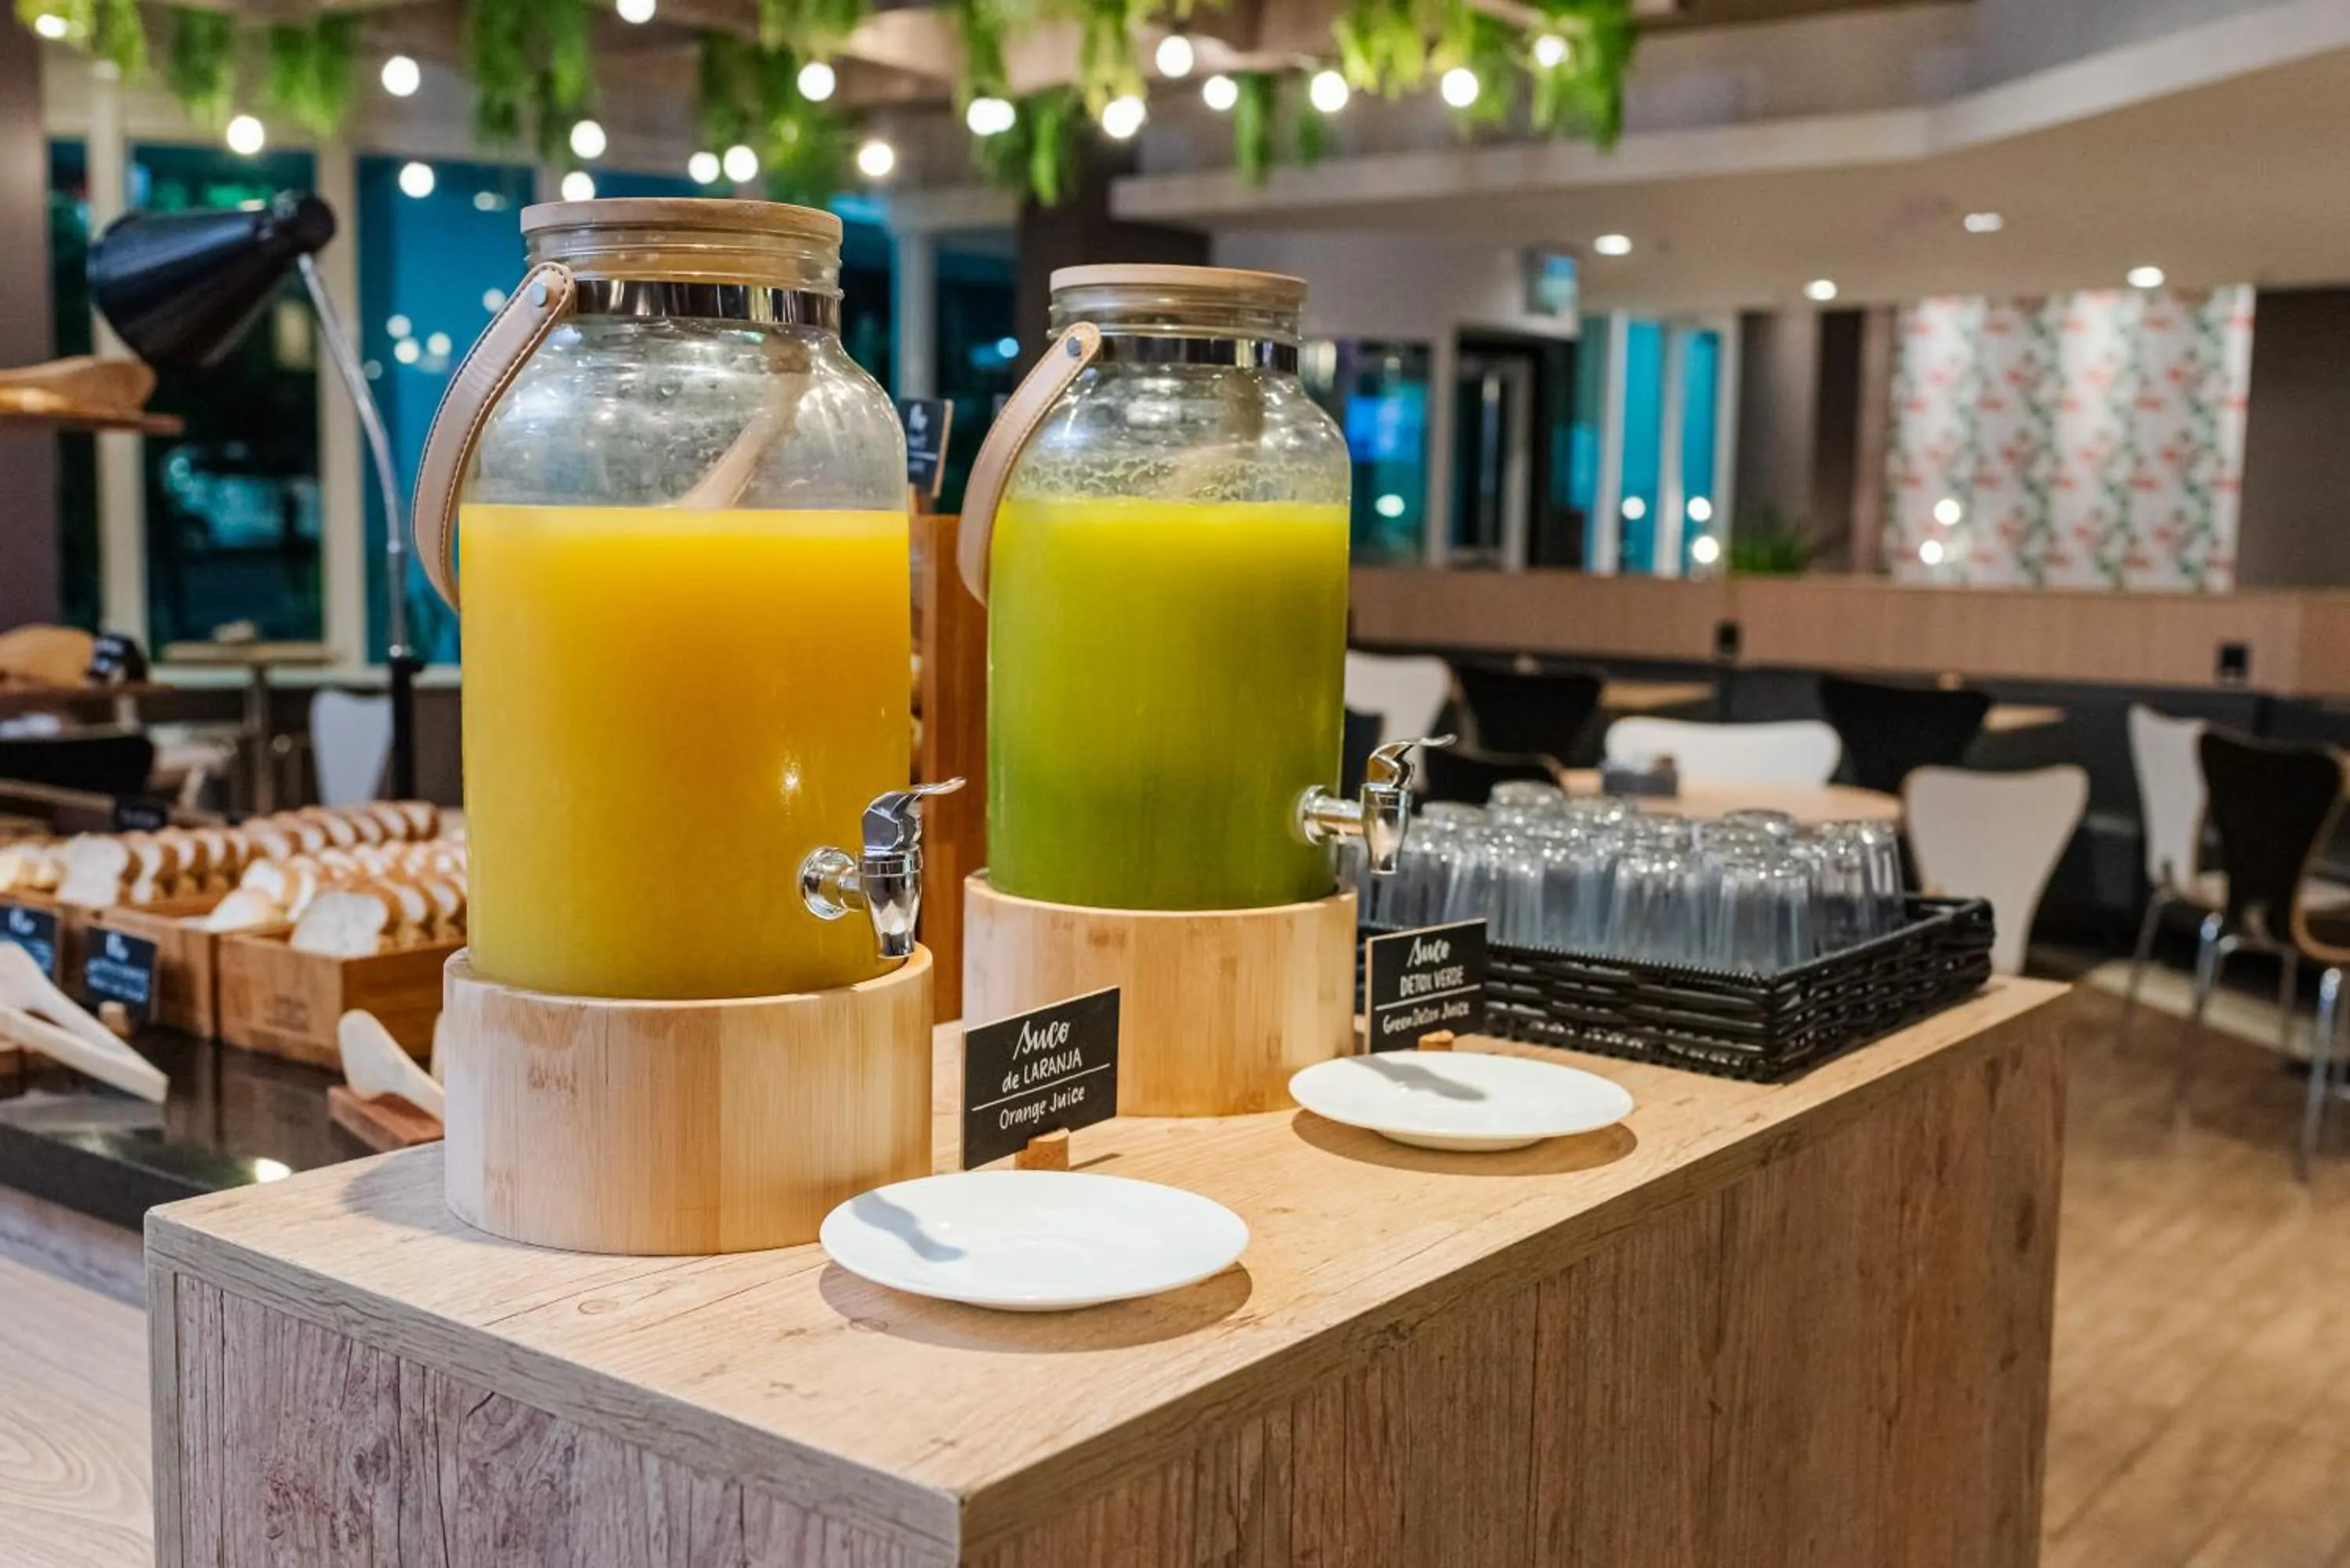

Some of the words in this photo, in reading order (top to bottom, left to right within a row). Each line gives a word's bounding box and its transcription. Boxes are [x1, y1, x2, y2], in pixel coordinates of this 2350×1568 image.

[1406, 937, 1451, 968] Suco
[1013, 1020, 1071, 1060] Suco
[1002, 1071, 1019, 1093] de
[1024, 1047, 1083, 1084] LARANJA
[999, 1100, 1047, 1129] Orange
[1049, 1086, 1086, 1112] Juice
